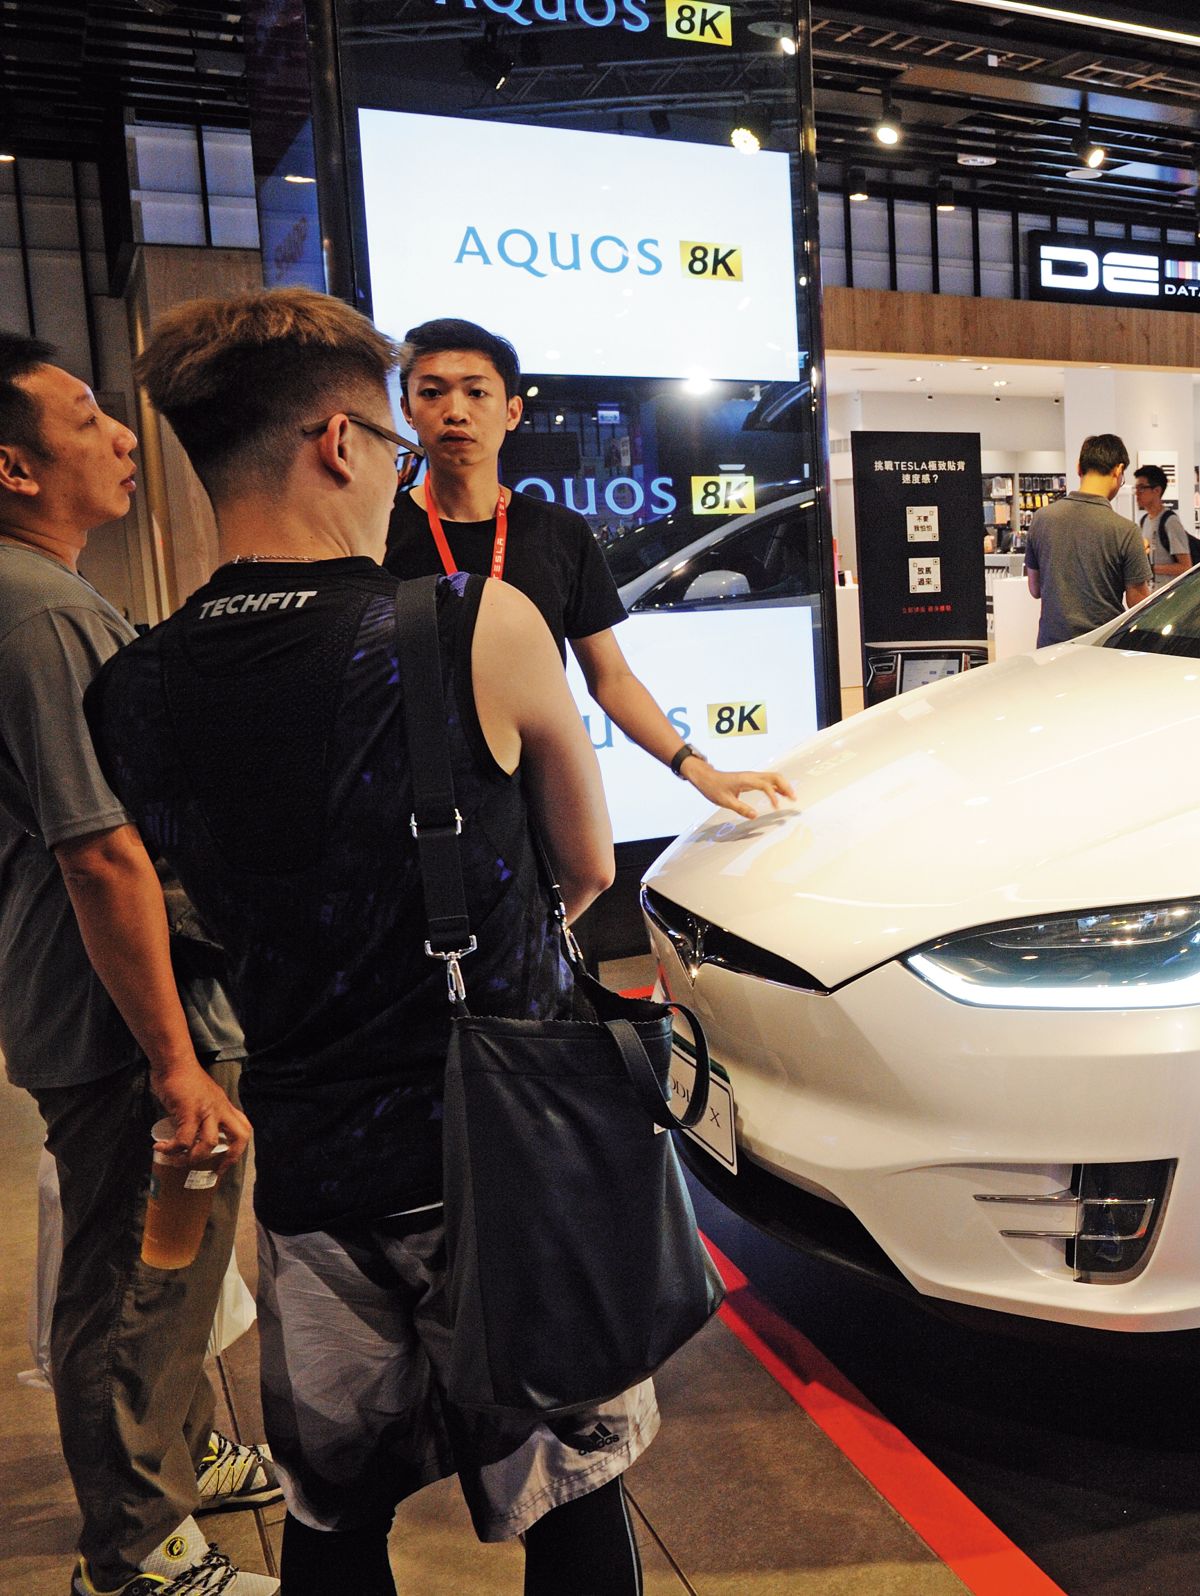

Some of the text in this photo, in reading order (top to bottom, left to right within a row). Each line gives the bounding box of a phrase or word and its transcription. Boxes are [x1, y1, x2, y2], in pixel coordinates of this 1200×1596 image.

[435, 0, 724, 39] UOS 8K
[453, 226, 738, 278] AQUOS 8K
[1040, 245, 1160, 296] DE
[515, 477, 748, 516] UOS 8K
[198, 591, 318, 620] TECHFIT
[714, 704, 763, 735] 8K
[709, 1106, 721, 1128] X
